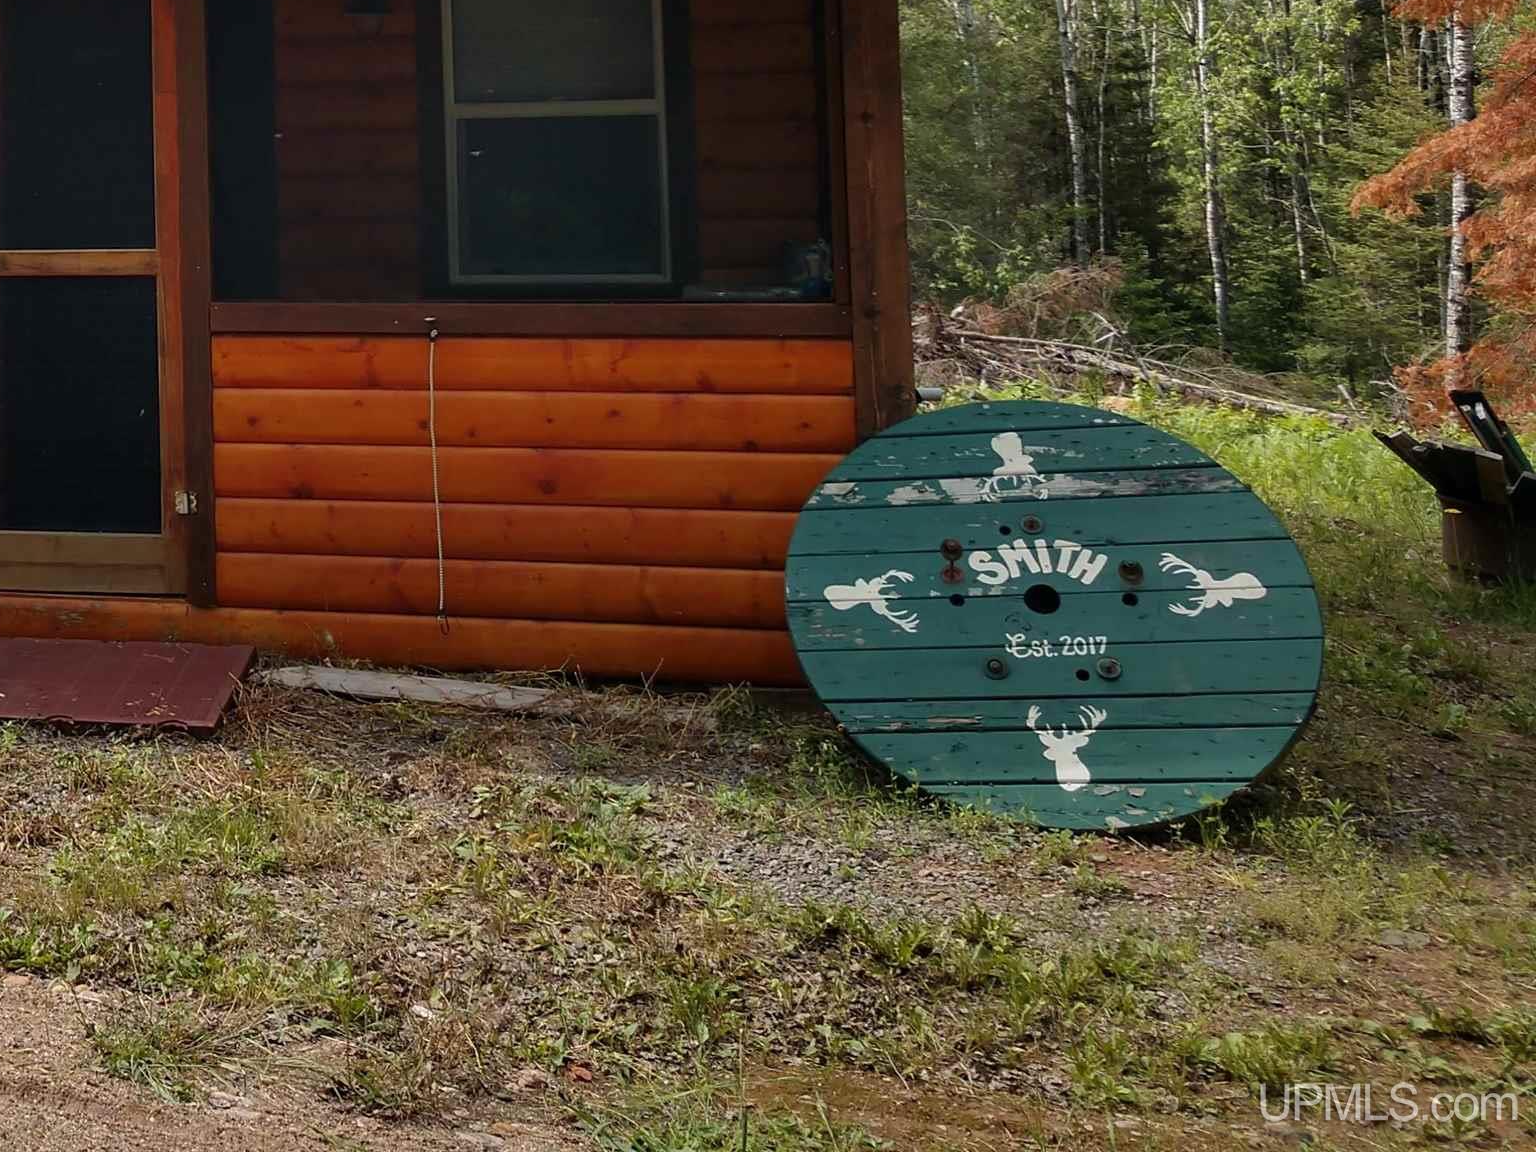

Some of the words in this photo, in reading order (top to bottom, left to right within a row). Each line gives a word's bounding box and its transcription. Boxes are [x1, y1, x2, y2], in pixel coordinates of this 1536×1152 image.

[969, 539, 1108, 585] SMITH
[1005, 633, 1058, 658] Est.
[1060, 635, 1107, 657] 2017
